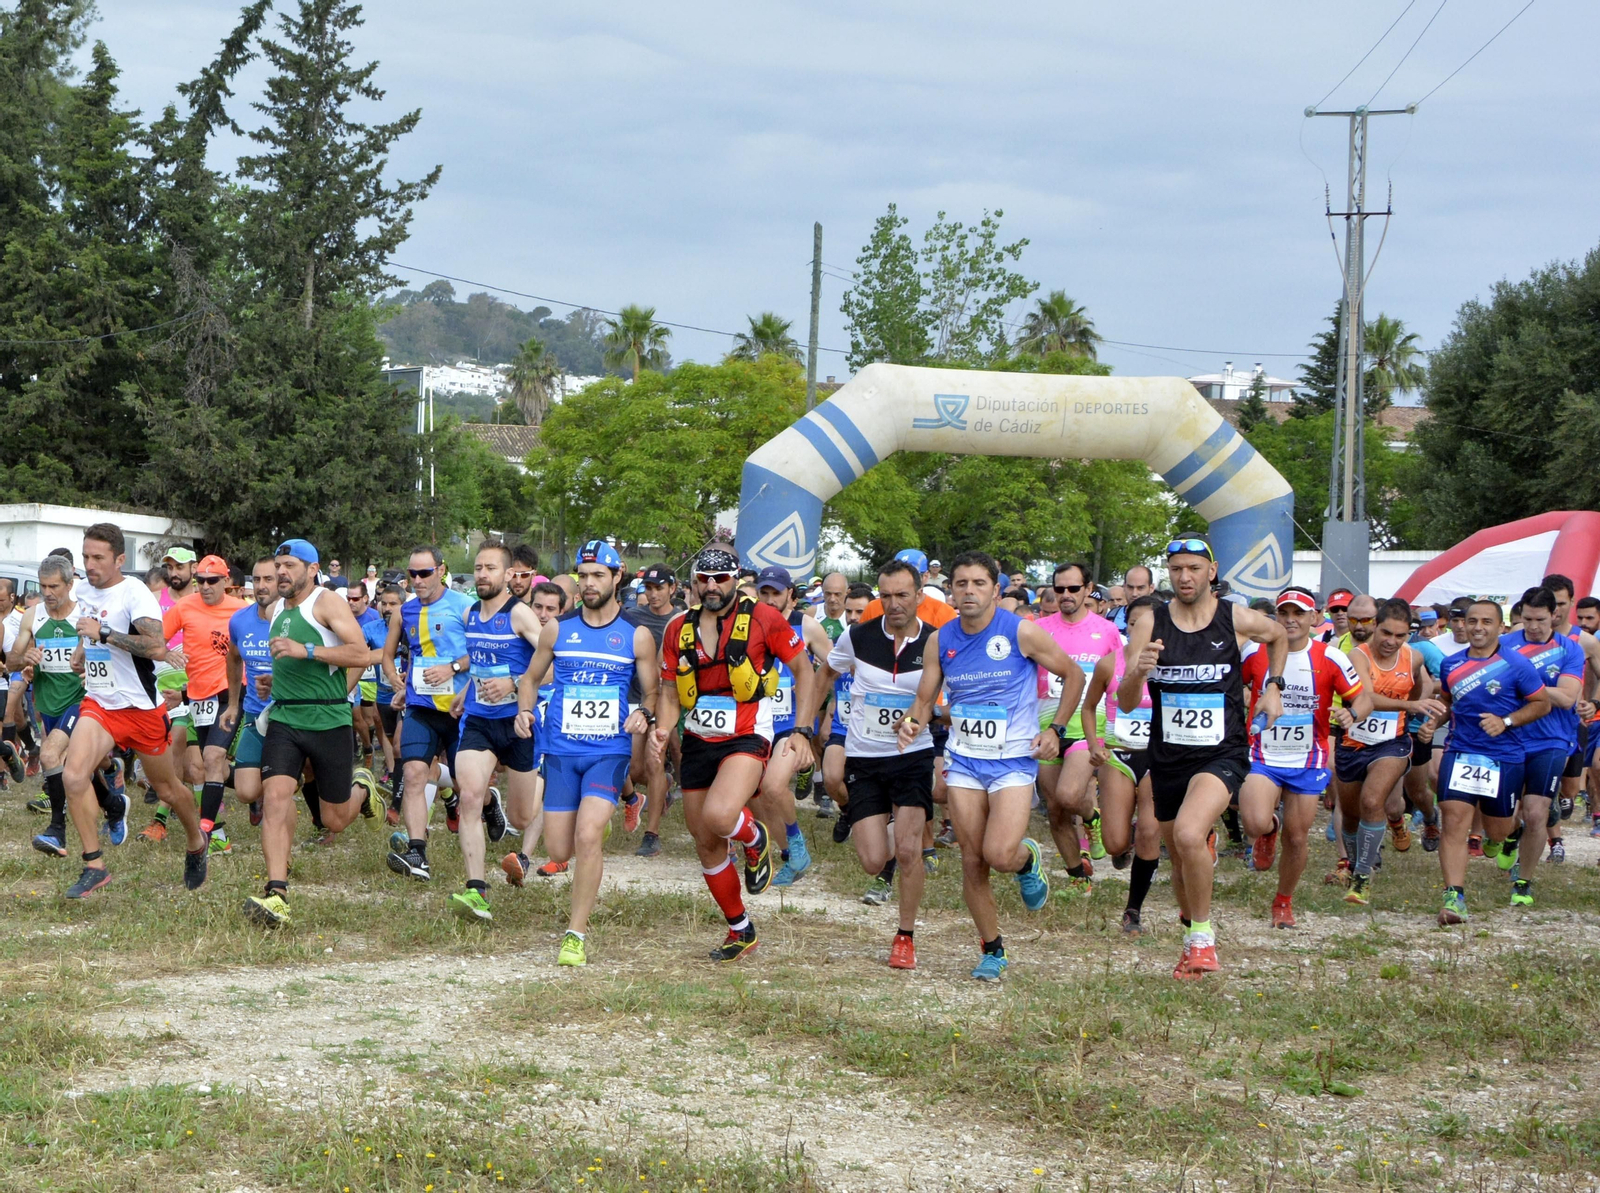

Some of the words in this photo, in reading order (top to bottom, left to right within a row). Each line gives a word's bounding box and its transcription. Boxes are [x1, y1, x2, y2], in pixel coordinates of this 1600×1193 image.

[976, 395, 1059, 414] Diputación
[1074, 402, 1149, 415] DEPORTES
[973, 417, 993, 433] de
[999, 417, 1042, 434] Cádiz
[242, 640, 256, 648] C.A.
[258, 640, 270, 648] CH
[475, 640, 510, 650] ATLETISMO
[43, 648, 72, 662] 315
[581, 660, 625, 671] ATLETISMO
[1461, 668, 1488, 687] JIMENA
[570, 700, 610, 719] 432
[691, 708, 727, 729] 426
[1171, 708, 1214, 729] 428
[1356, 718, 1388, 735] 261
[960, 718, 997, 740] 440
[1269, 726, 1305, 741] 175
[1460, 765, 1492, 783] 244
